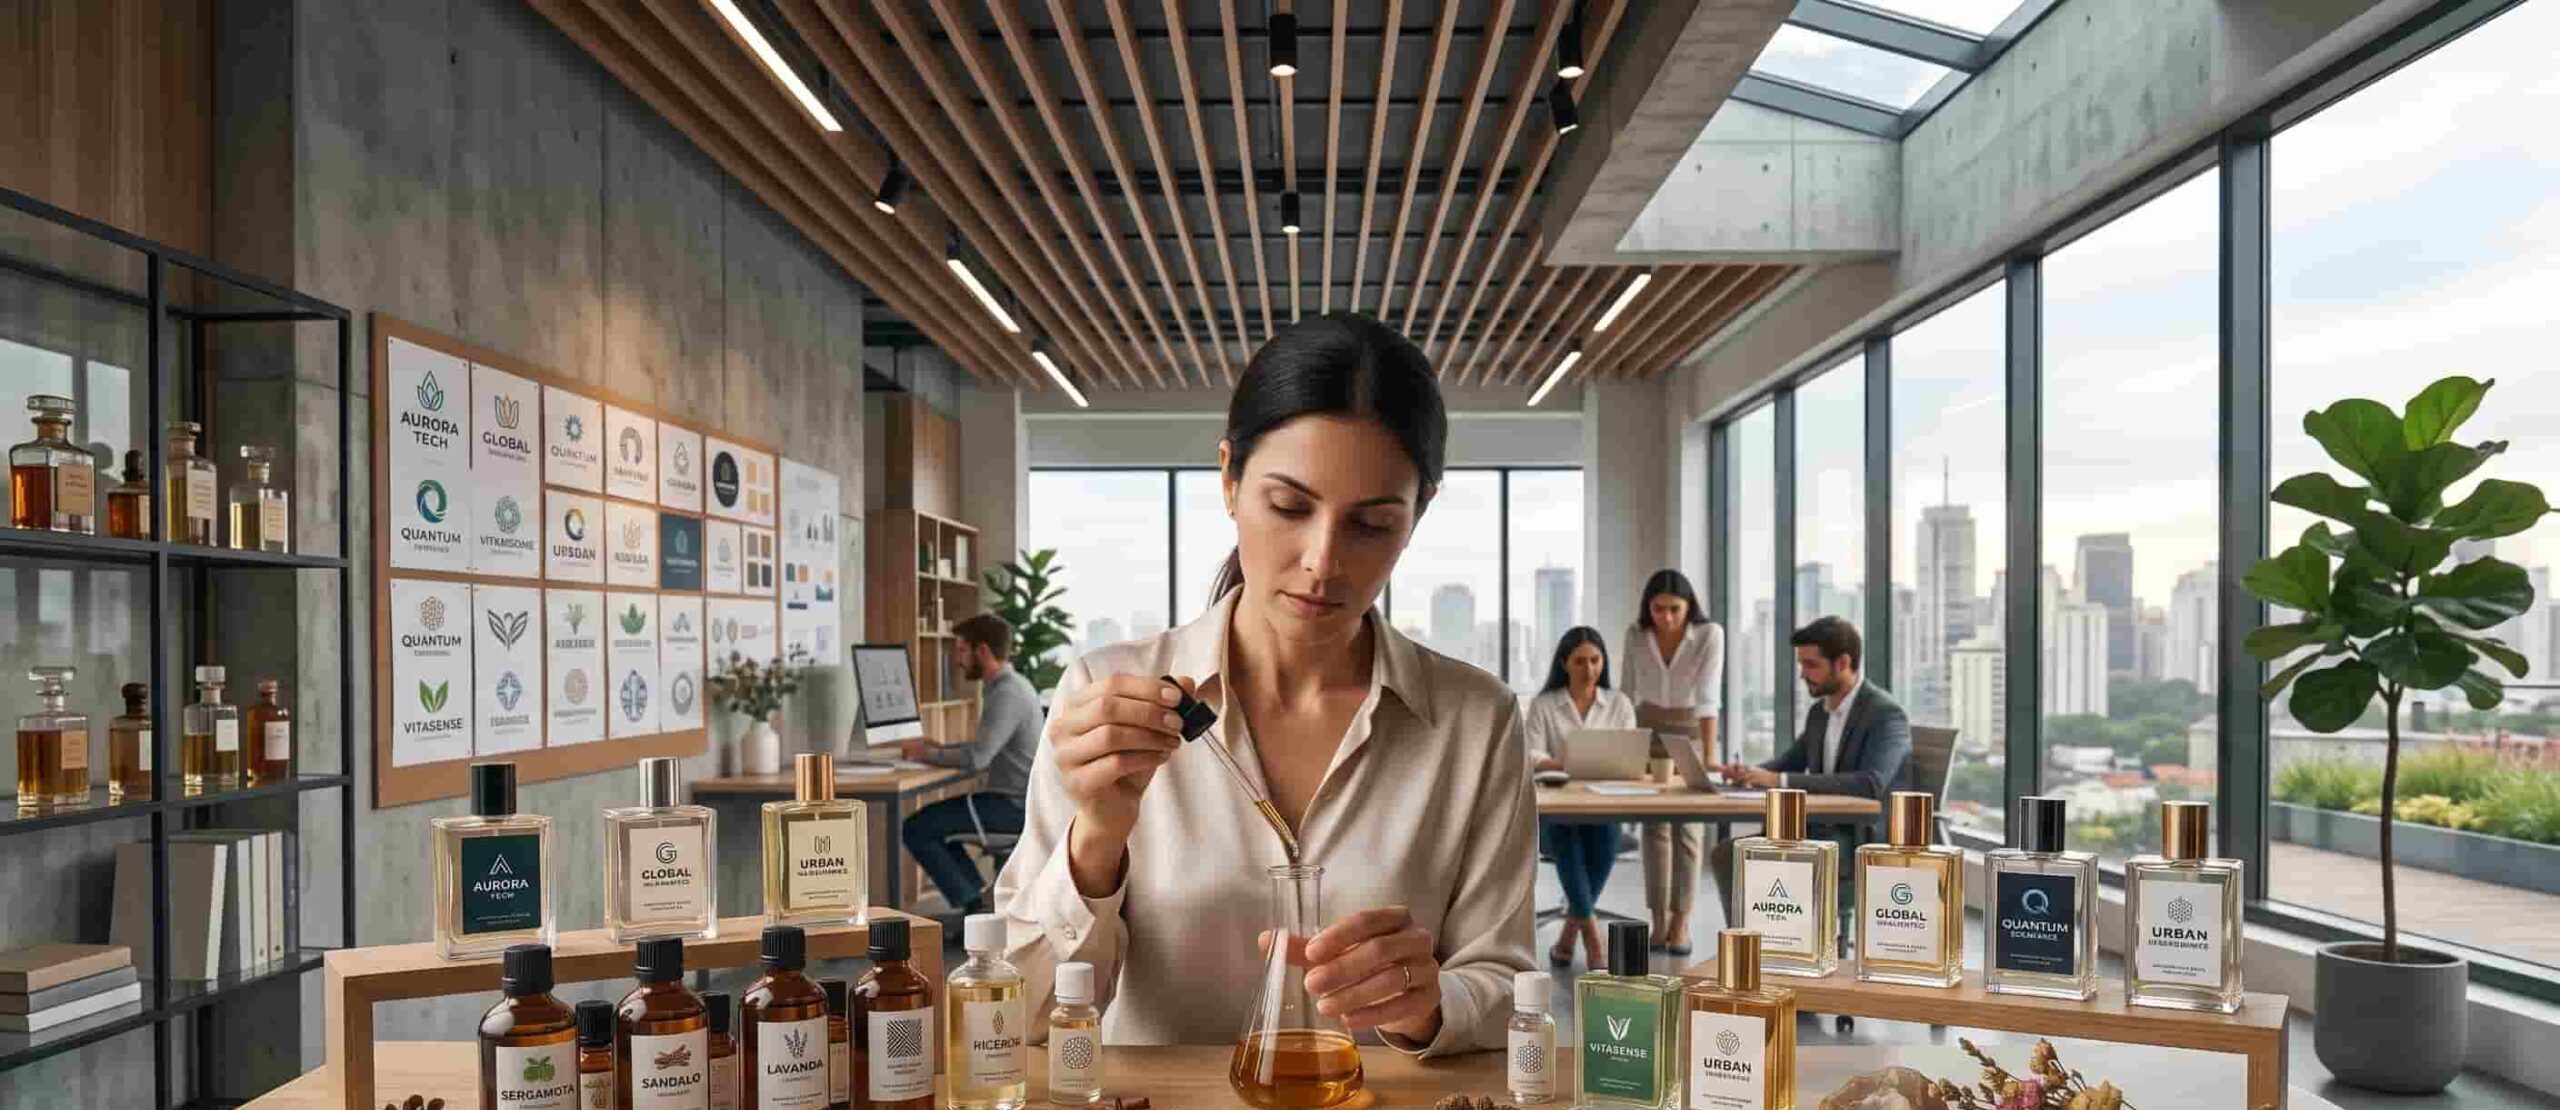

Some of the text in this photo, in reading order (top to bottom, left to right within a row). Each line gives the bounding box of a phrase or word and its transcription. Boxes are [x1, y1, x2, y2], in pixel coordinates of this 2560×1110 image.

[400, 411, 459, 436] AURORA
[413, 430, 448, 449] TECH
[483, 431, 531, 454] GLOBAL
[401, 527, 462, 545] QUANTUM
[402, 634, 462, 648] QUANTUM
[404, 717, 464, 734] VITASENSE
[800, 856, 845, 869] URBAN
[473, 879, 529, 892] AURORA
[1752, 901, 1803, 915] AURORA
[1875, 908, 1927, 922] GLOBAL
[2002, 917, 2068, 934] QUANTUM
[2152, 926, 2208, 941] URBAN
[1590, 1042, 1648, 1058] VITASENSE
[767, 1059, 824, 1076] LAVANDA
[1703, 1057, 1752, 1075] URBAN
[642, 1072, 701, 1089] SANDALO
[501, 1083, 575, 1102] SERGAMOTA
